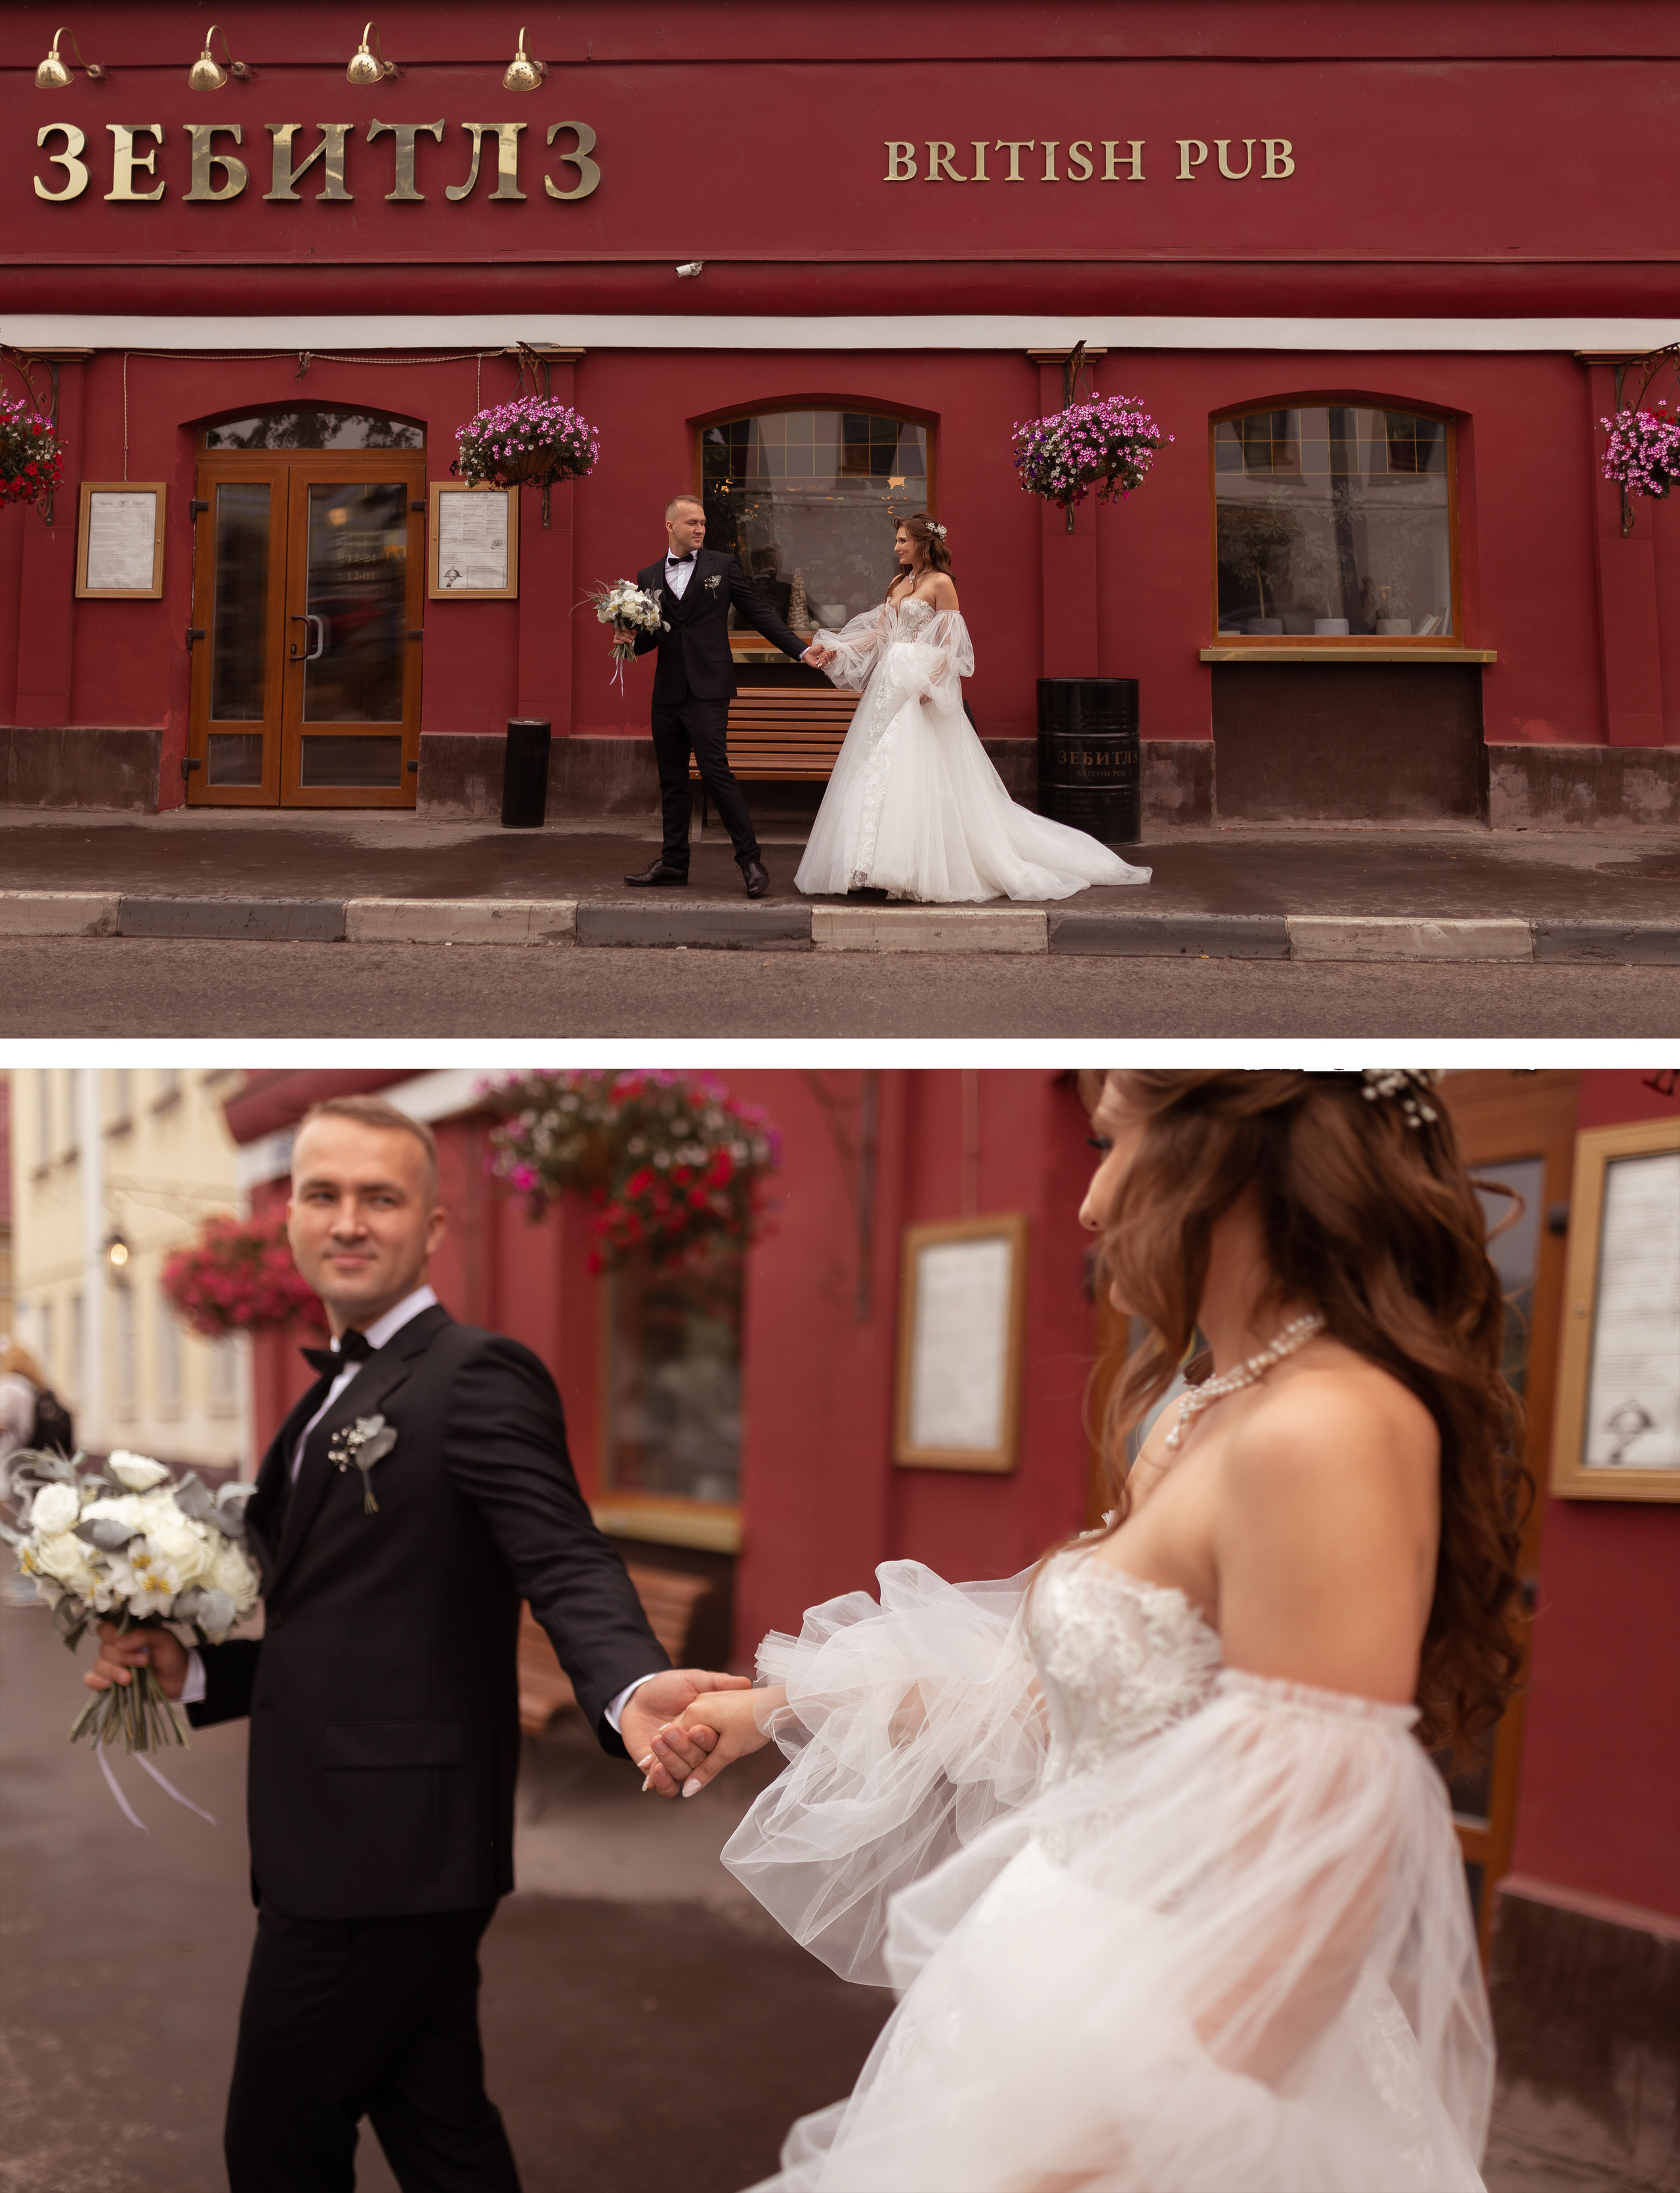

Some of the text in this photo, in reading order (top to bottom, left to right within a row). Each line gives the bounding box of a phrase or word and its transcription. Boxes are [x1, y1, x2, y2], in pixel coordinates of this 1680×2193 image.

[33, 118, 601, 202] ЗЕБИТЛЗ
[883, 138, 1295, 182] BRITISH PUB
[1059, 751, 1137, 765] ЗЕБИТЛЗ
